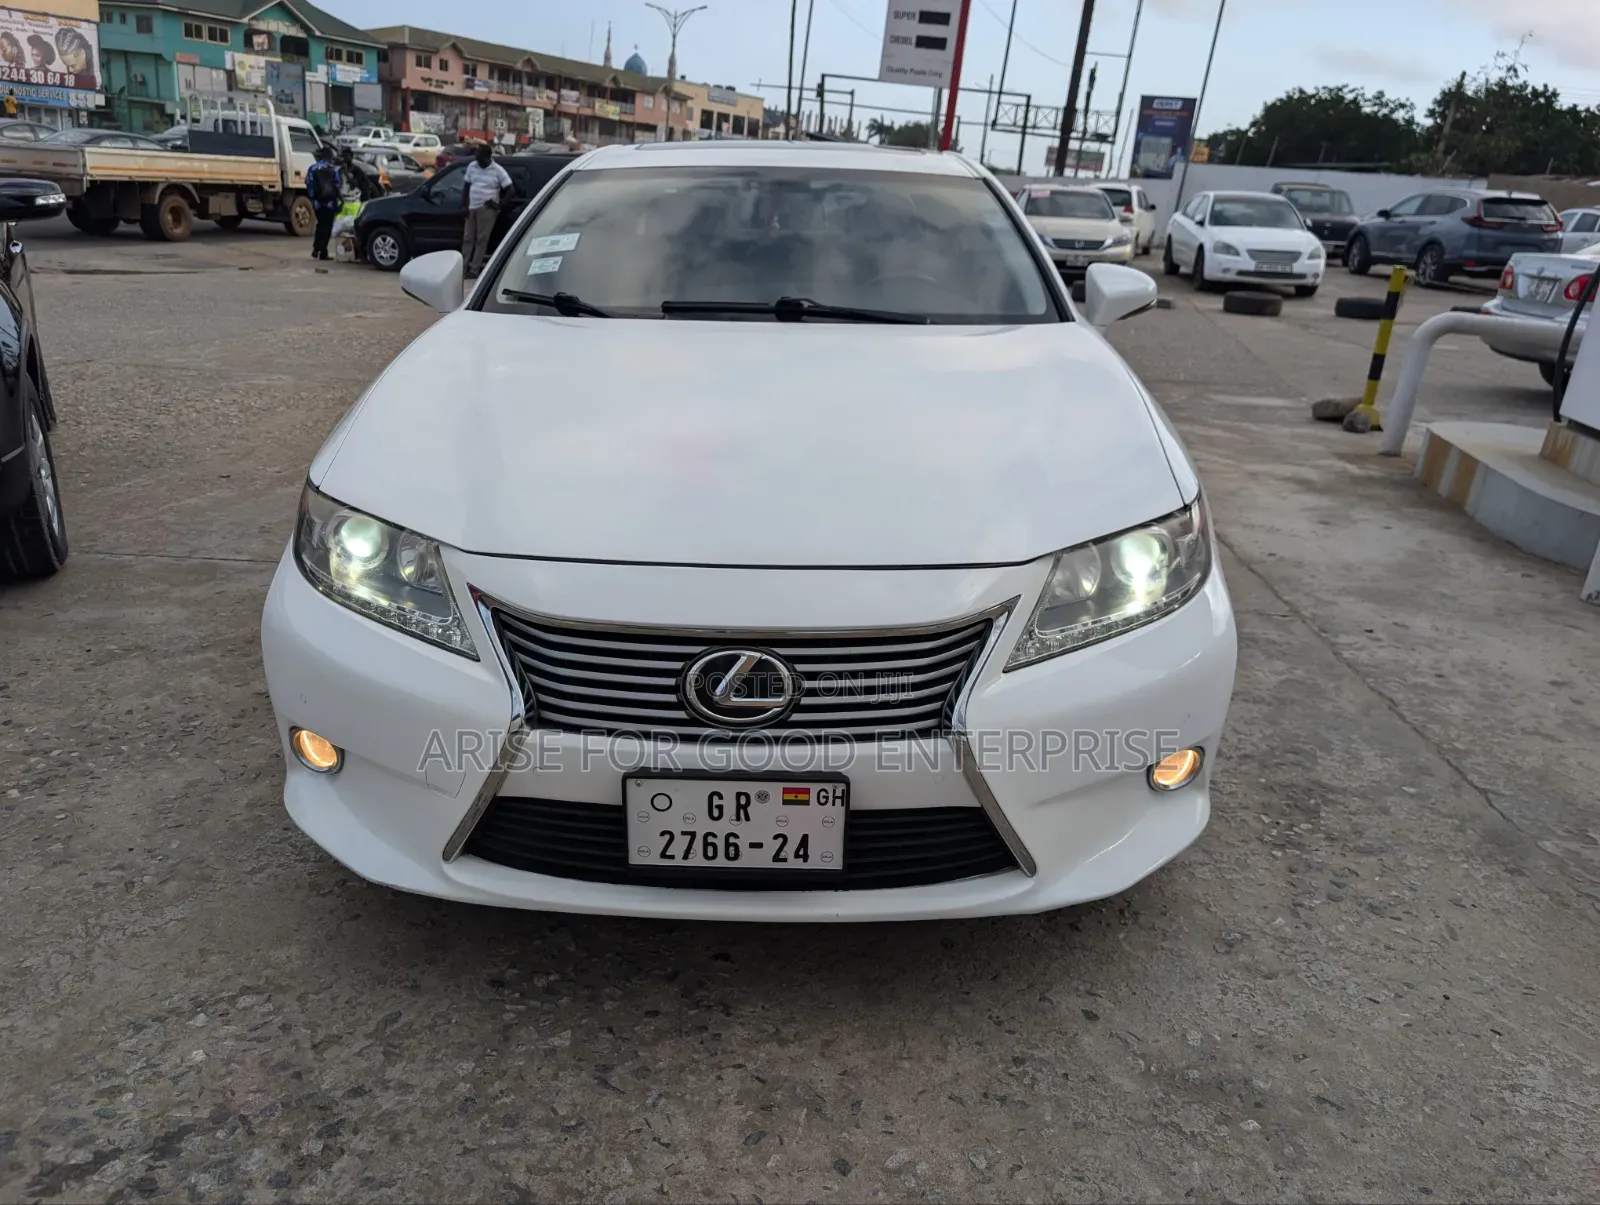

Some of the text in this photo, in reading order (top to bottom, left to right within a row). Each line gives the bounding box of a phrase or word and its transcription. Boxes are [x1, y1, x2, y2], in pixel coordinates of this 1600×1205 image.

[30, 70, 44, 84] 30
[47, 72, 60, 85] 64
[64, 74, 75, 87] 18
[38, 89, 66, 100] SERVICES
[707, 790, 752, 822] GR
[816, 788, 846, 807] GH
[659, 829, 810, 863] 2766-24
